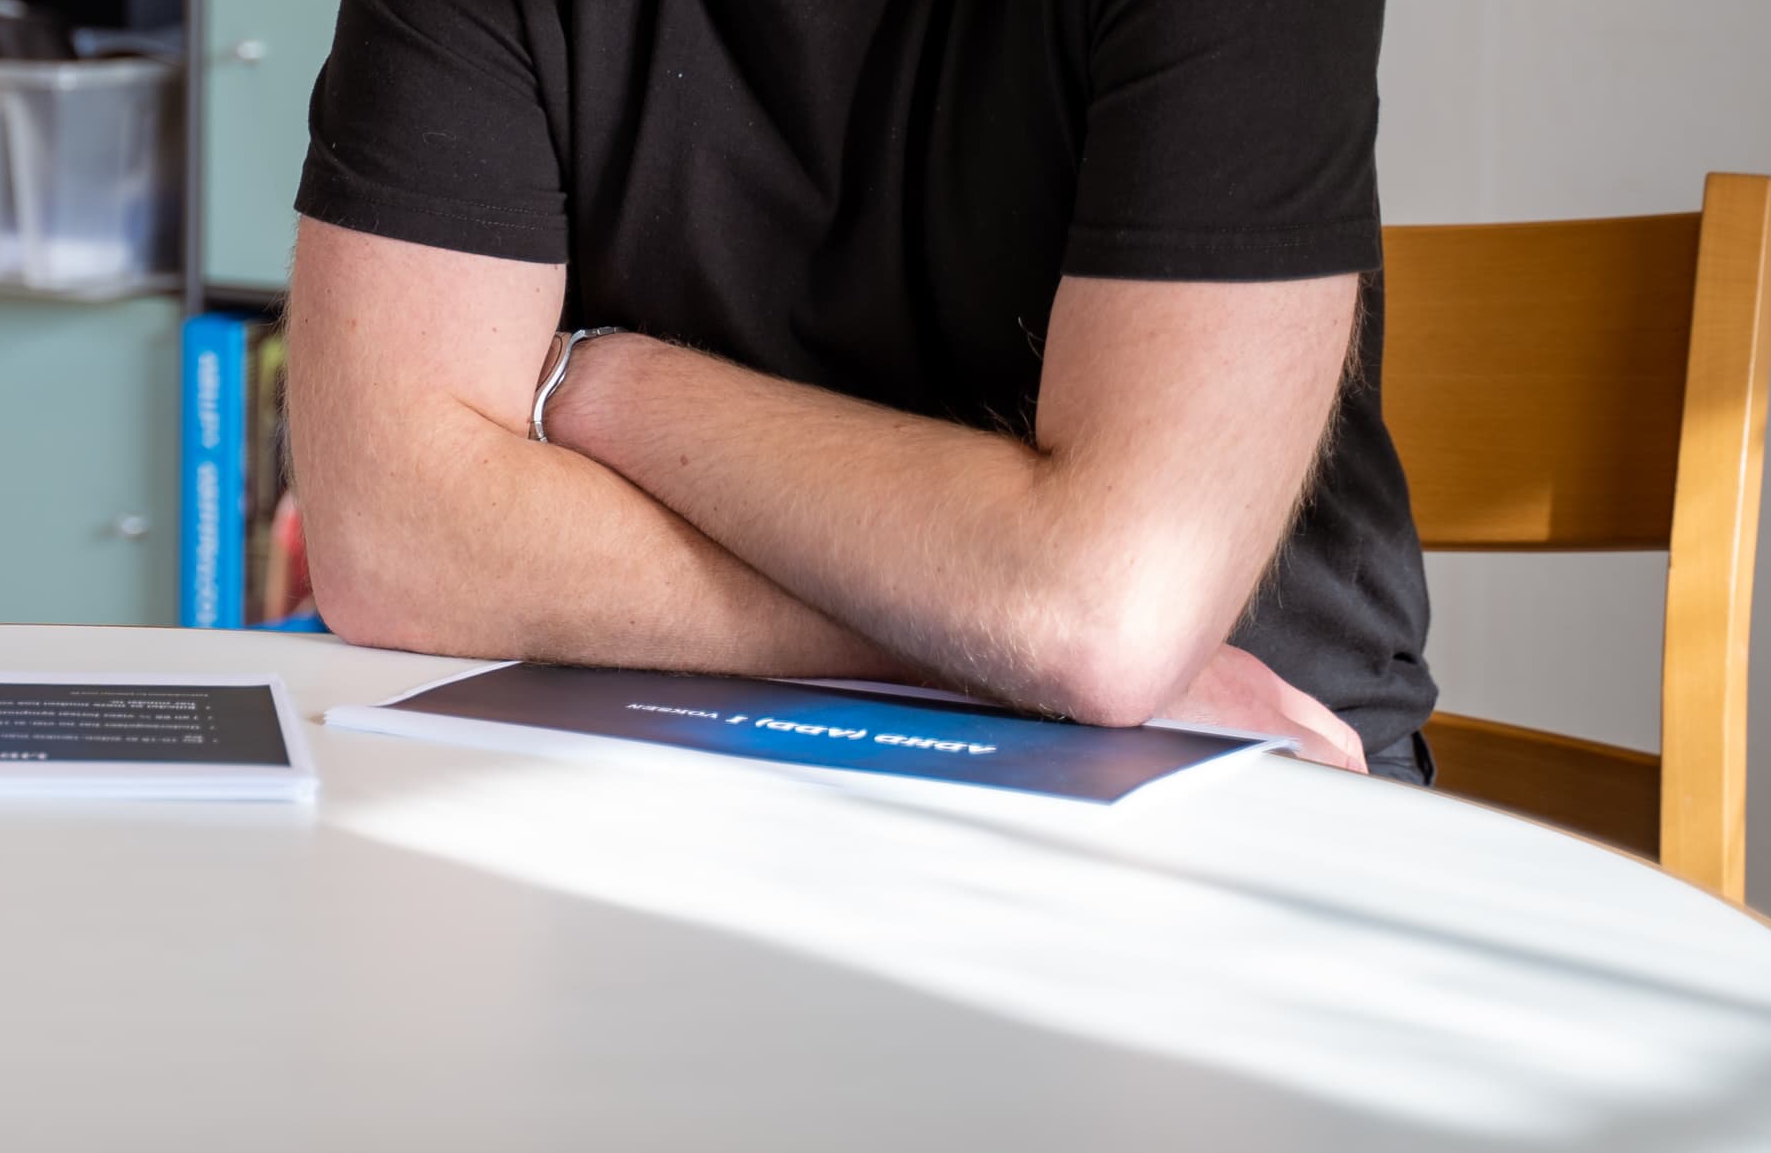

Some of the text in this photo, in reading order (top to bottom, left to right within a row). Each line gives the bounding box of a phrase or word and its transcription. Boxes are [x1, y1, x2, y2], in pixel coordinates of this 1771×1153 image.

[626, 703, 720, 719] VOKSEN
[755, 717, 868, 740] (ADD)
[873, 735, 998, 756] ADHD
